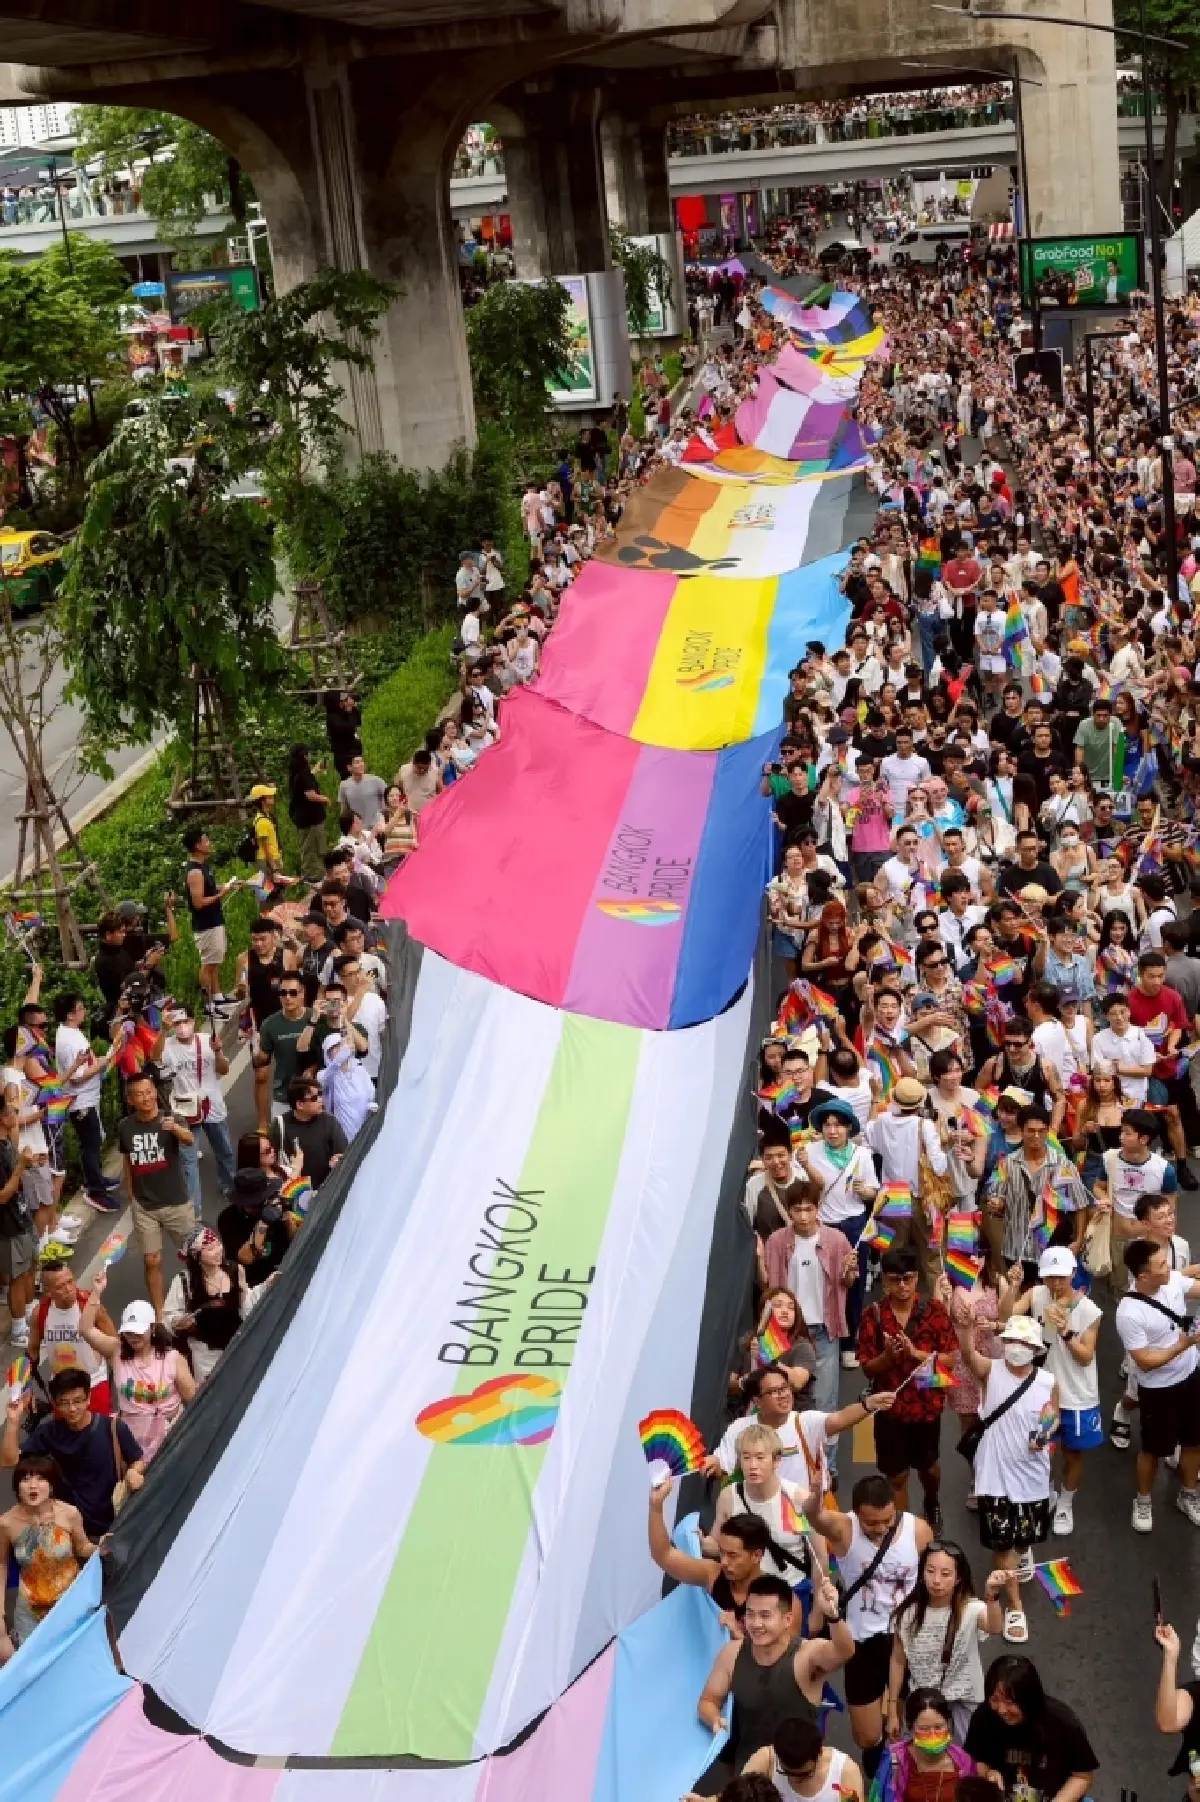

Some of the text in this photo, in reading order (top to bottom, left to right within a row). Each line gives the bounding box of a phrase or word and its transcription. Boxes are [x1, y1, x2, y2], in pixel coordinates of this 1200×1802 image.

[1034, 242, 1124, 260] GrabFood No.1
[602, 823, 655, 894] BANGKOK
[647, 856, 691, 899] PRIDE
[130, 1147, 166, 1165] PACK
[132, 1133, 159, 1151] SIX
[437, 1176, 546, 1367] BANGKOK
[513, 1263, 596, 1367] PRIDE
